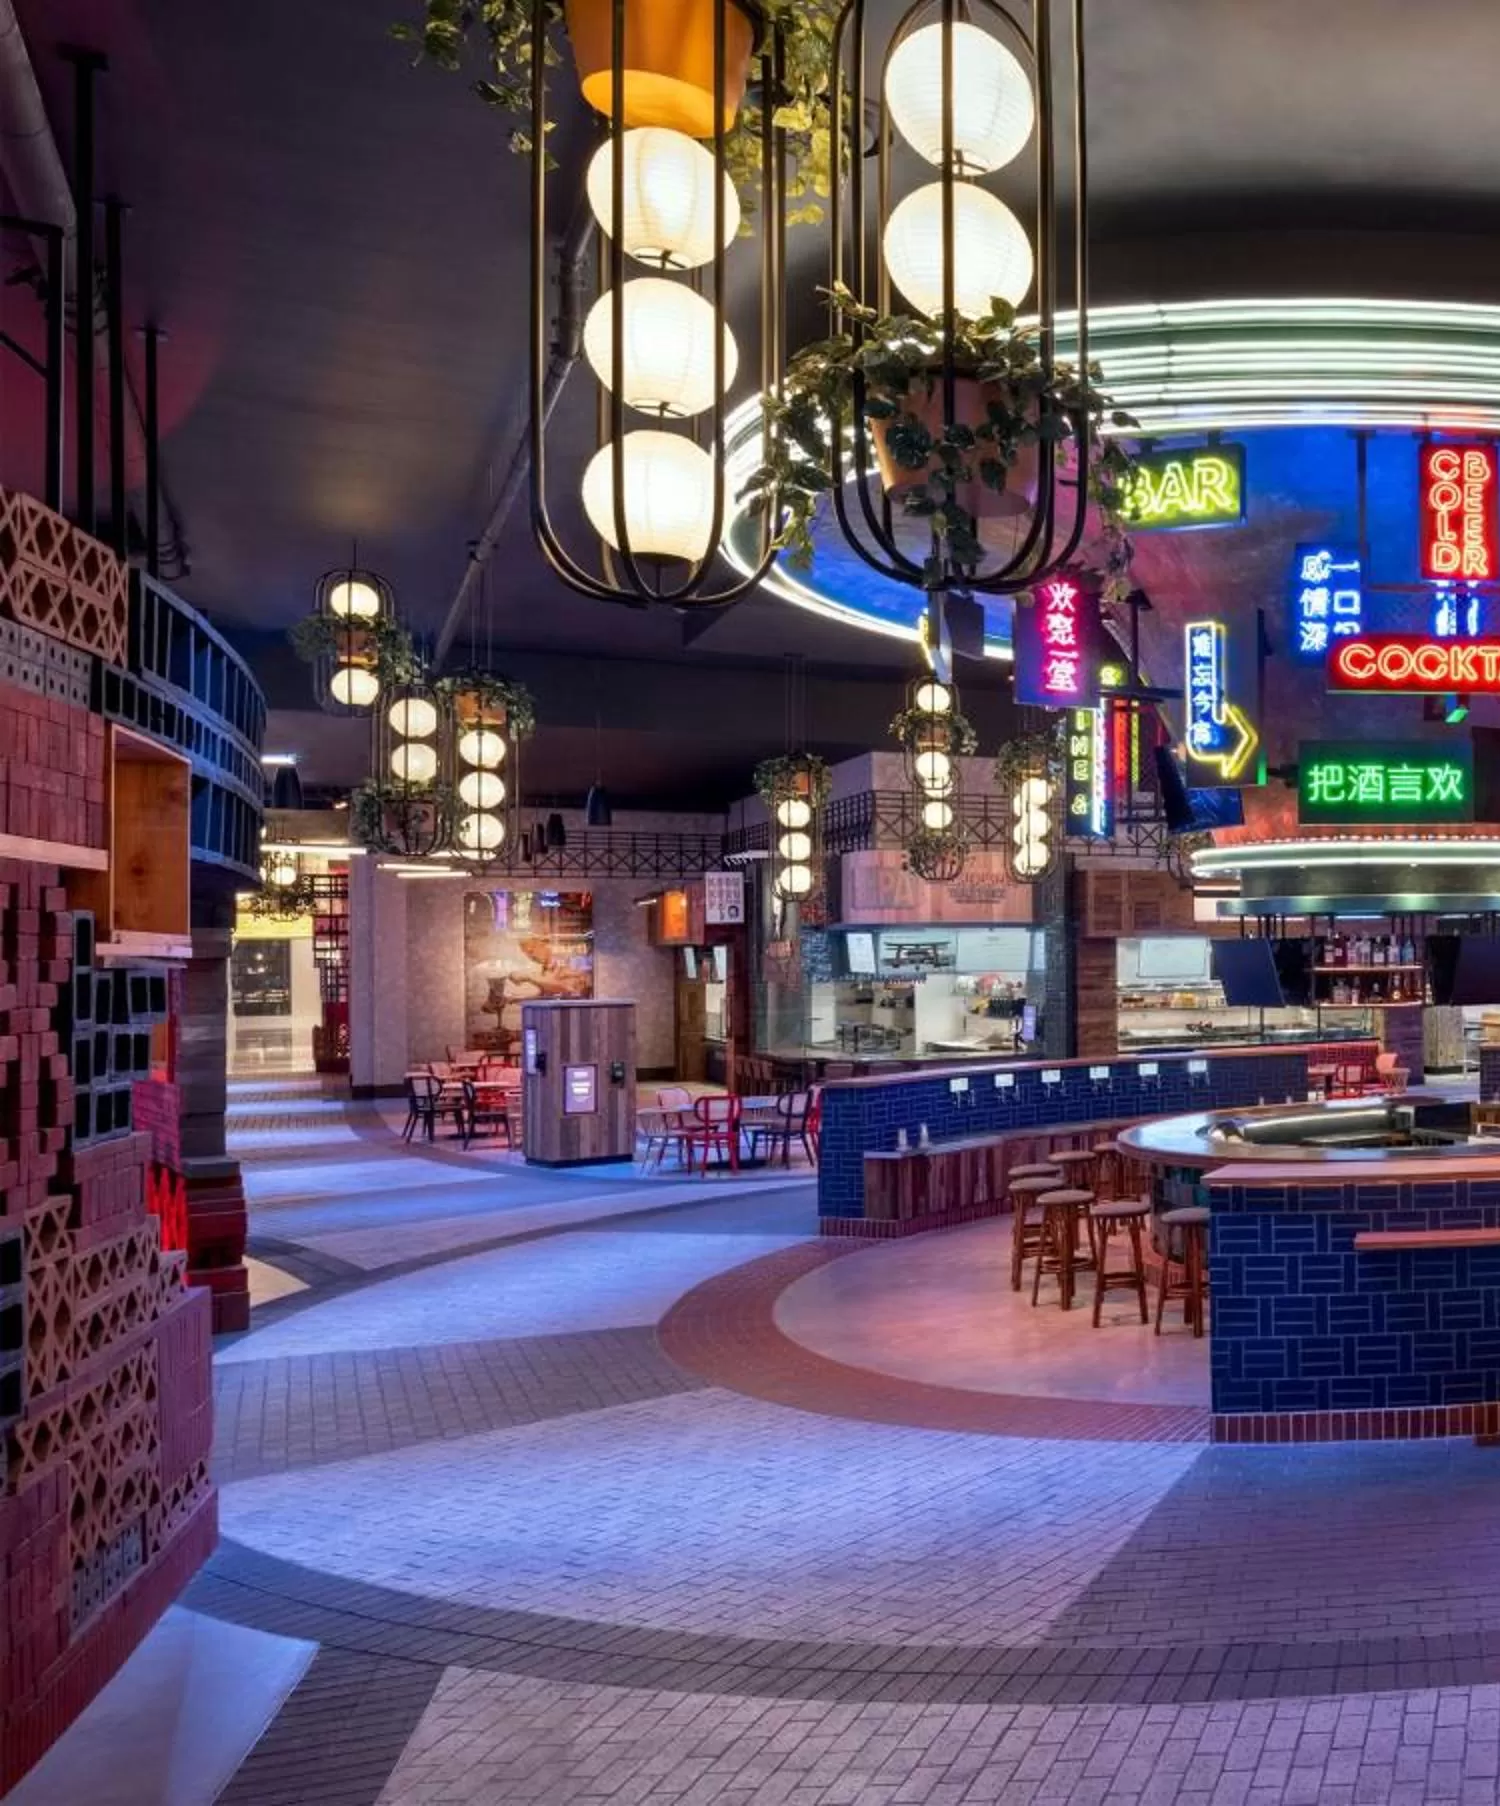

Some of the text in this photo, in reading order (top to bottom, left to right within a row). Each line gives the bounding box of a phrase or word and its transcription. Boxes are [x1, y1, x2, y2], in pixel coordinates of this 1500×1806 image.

[1117, 458, 1233, 516] BAR
[1429, 449, 1490, 575] COLD BEER
[1308, 762, 1464, 802] 把酒言欢
